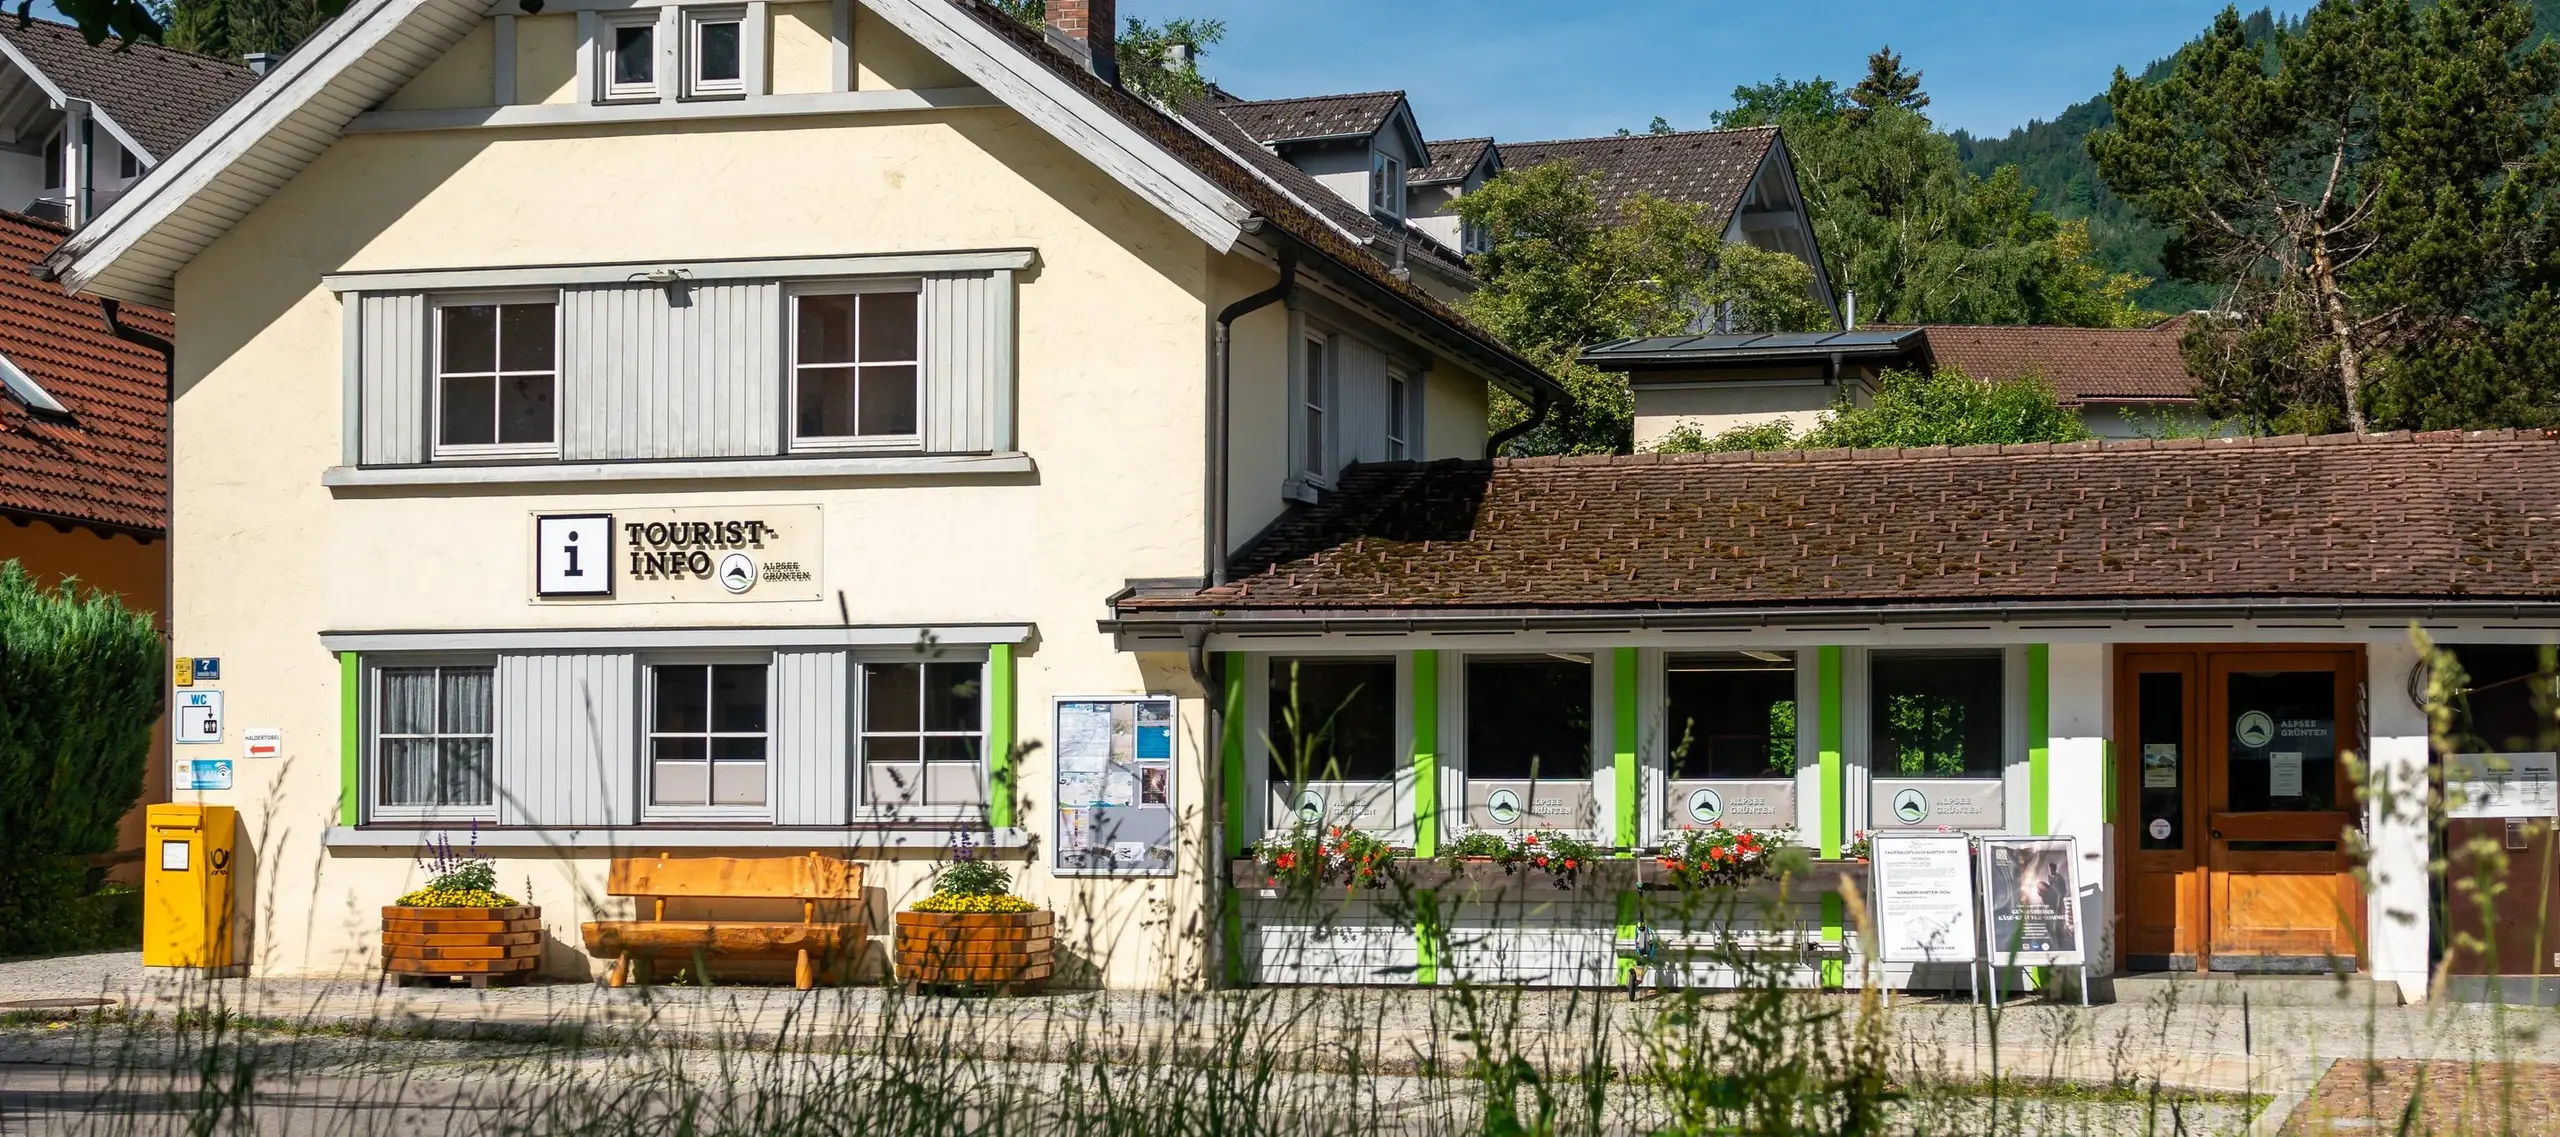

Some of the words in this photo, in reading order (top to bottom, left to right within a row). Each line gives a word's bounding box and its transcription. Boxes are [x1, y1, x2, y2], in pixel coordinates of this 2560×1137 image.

[625, 520, 775, 546] TOURIST-
[629, 551, 711, 575] INFO
[762, 562, 800, 570] ALPSEE
[202, 660, 210, 671] 7
[191, 694, 208, 705] WC
[2281, 720, 2317, 728] ALPSEE
[2281, 728, 2328, 737] GRÜNTEN
[1730, 797, 1765, 806] ALPSEE
[1936, 797, 1972, 806] ALPSEE
[1730, 805, 1776, 815] GRÜNTEN
[1936, 805, 1983, 815] GRÜNTEN
